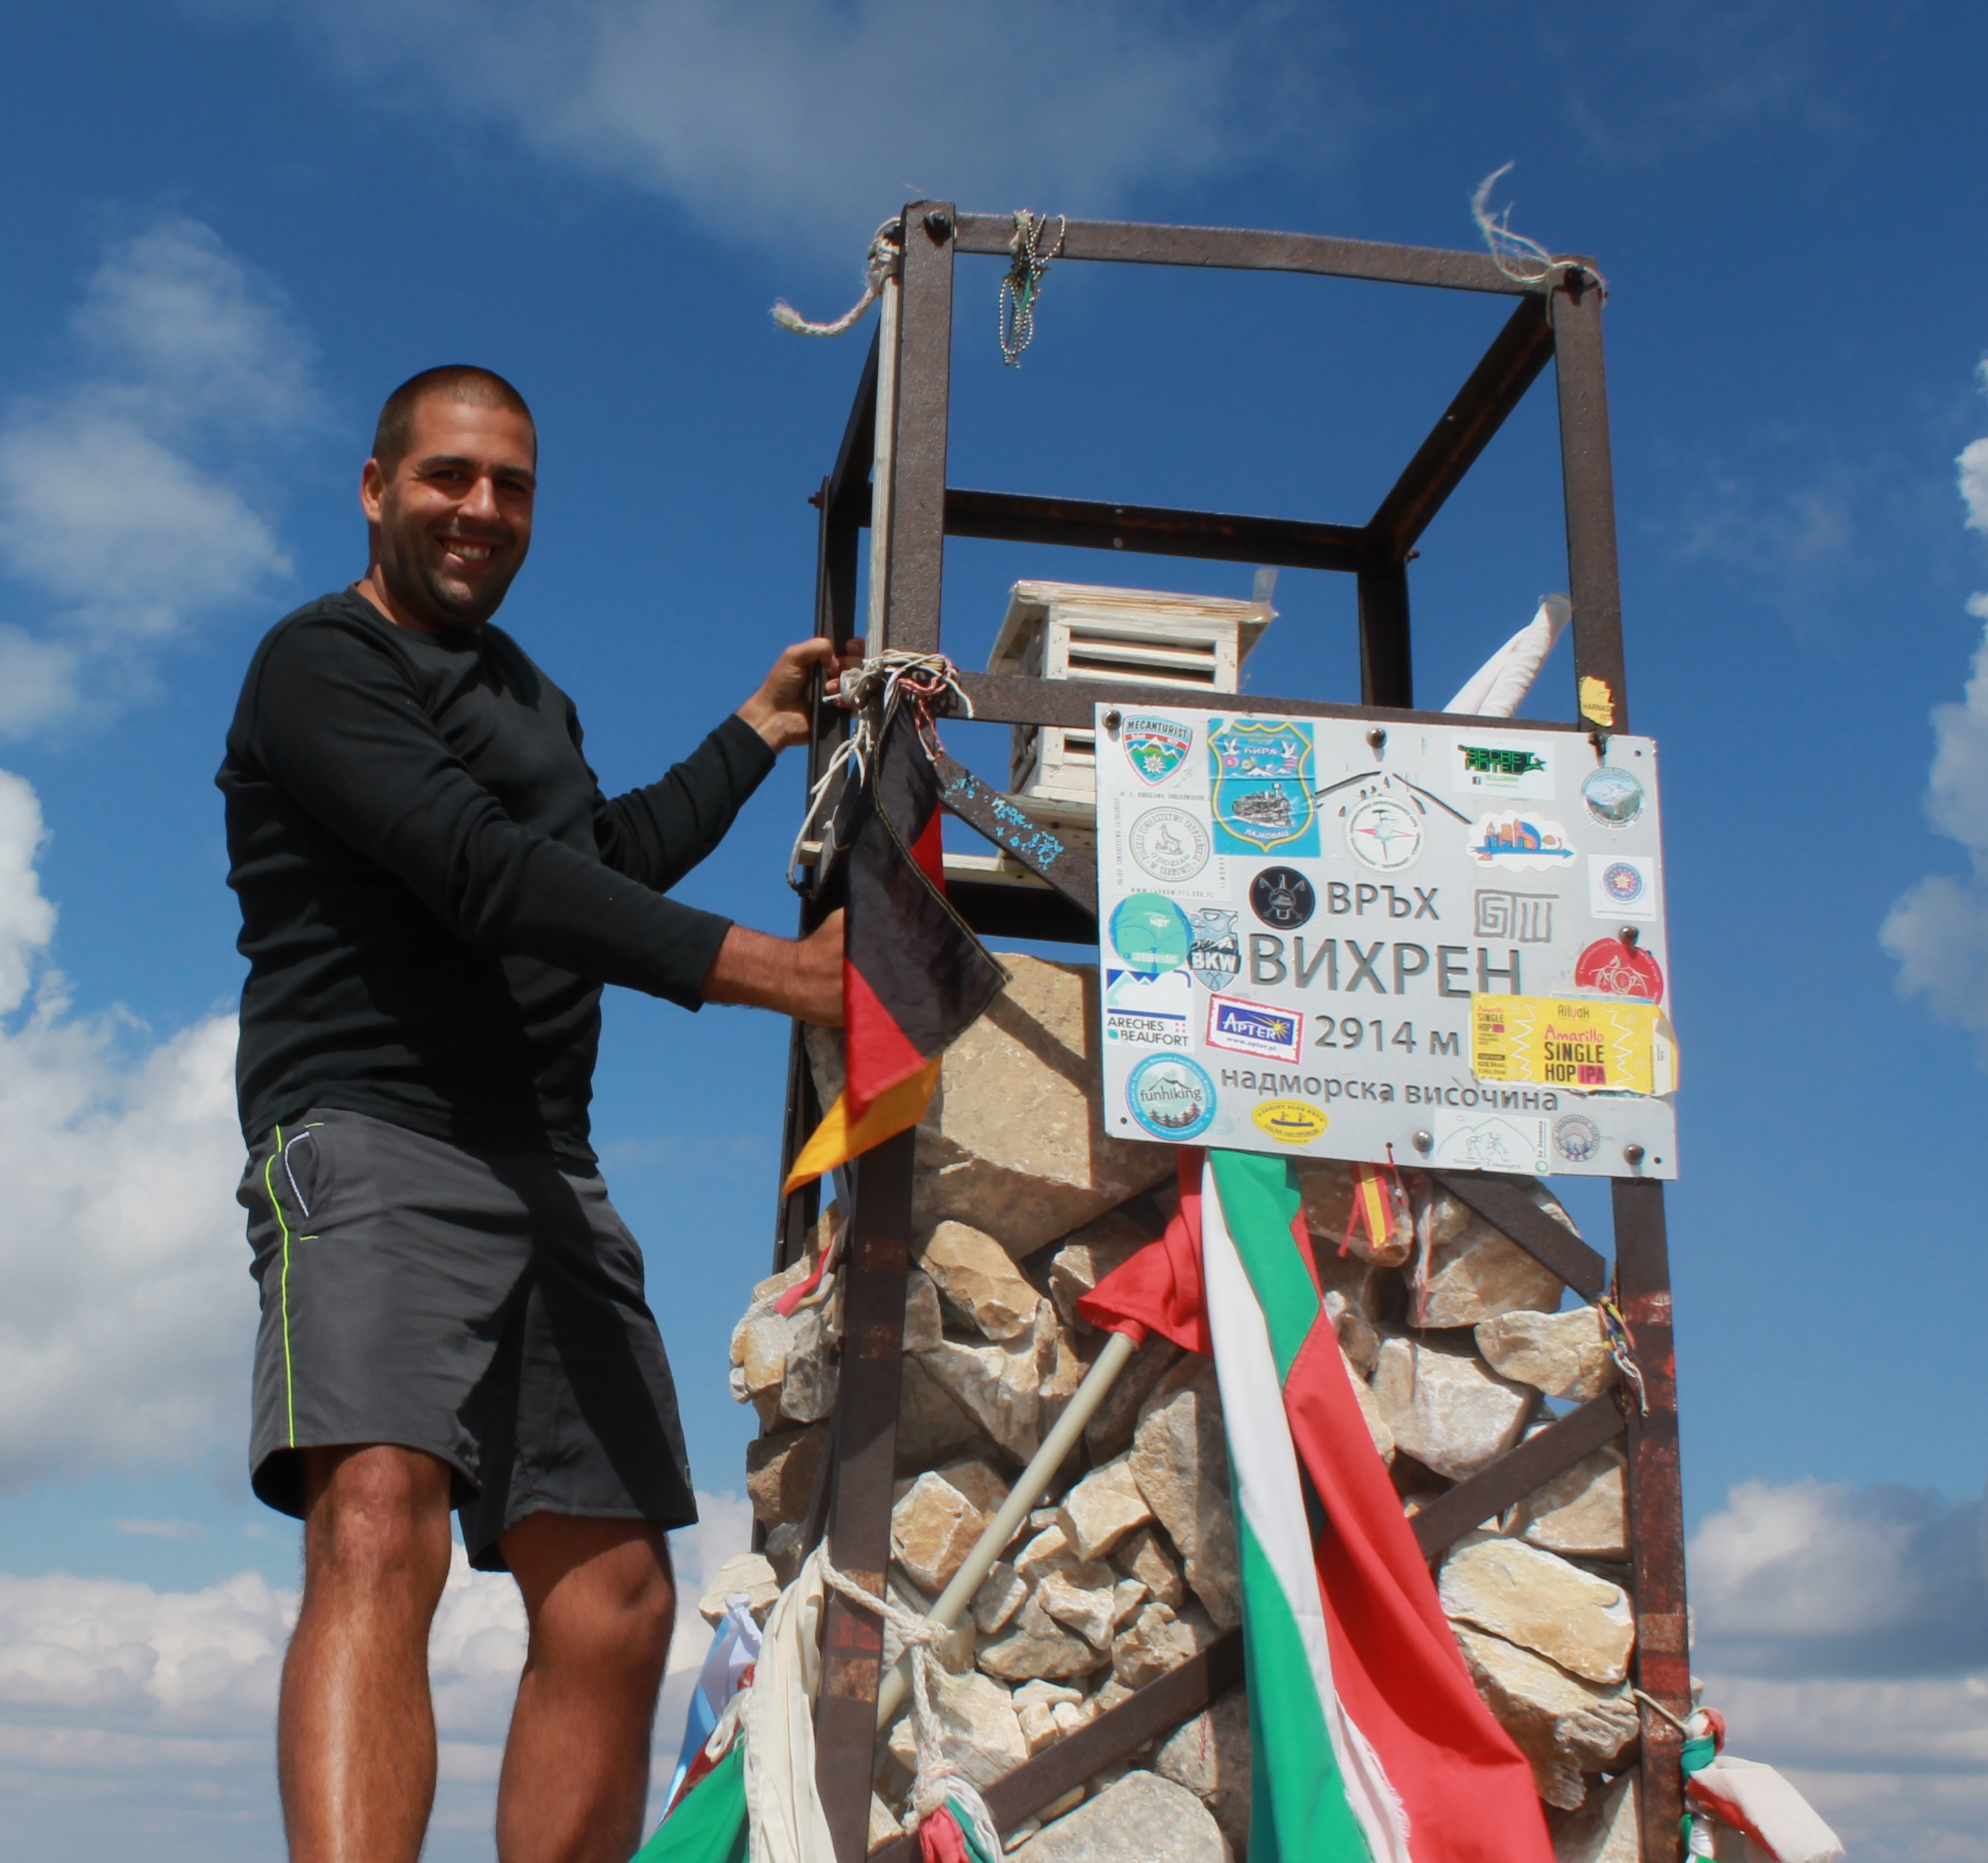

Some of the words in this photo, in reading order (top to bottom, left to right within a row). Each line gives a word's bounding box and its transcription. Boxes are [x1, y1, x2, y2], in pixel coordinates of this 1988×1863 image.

[1127, 720, 1187, 739] MECANTURIST
[1465, 747, 1534, 766] SECRET
[1465, 759, 1524, 776] HOTEL
[1327, 881, 1440, 920] ВРЪХ
[1192, 952, 1237, 972] BKW
[1248, 933, 1521, 999] ВИХРЕН
[1477, 1013, 1504, 1023] SINGLE
[1557, 1004, 1589, 1020] Ailyak
[1107, 1017, 1165, 1031] ARECHES
[1222, 1012, 1276, 1040] APTER
[1544, 1024, 1604, 1043] Amarillo
[1121, 1030, 1189, 1046] BEAUFORT
[1314, 1014, 1417, 1054] 2914
[1429, 1031, 1459, 1057] м
[1544, 1041, 1605, 1063] SINGLE
[1545, 1063, 1576, 1082] HOP
[1578, 1065, 1605, 1084] IPA
[1140, 1085, 1202, 1101] funhiking
[1220, 1068, 1395, 1104] надморска
[1405, 1083, 1559, 1112] височина
